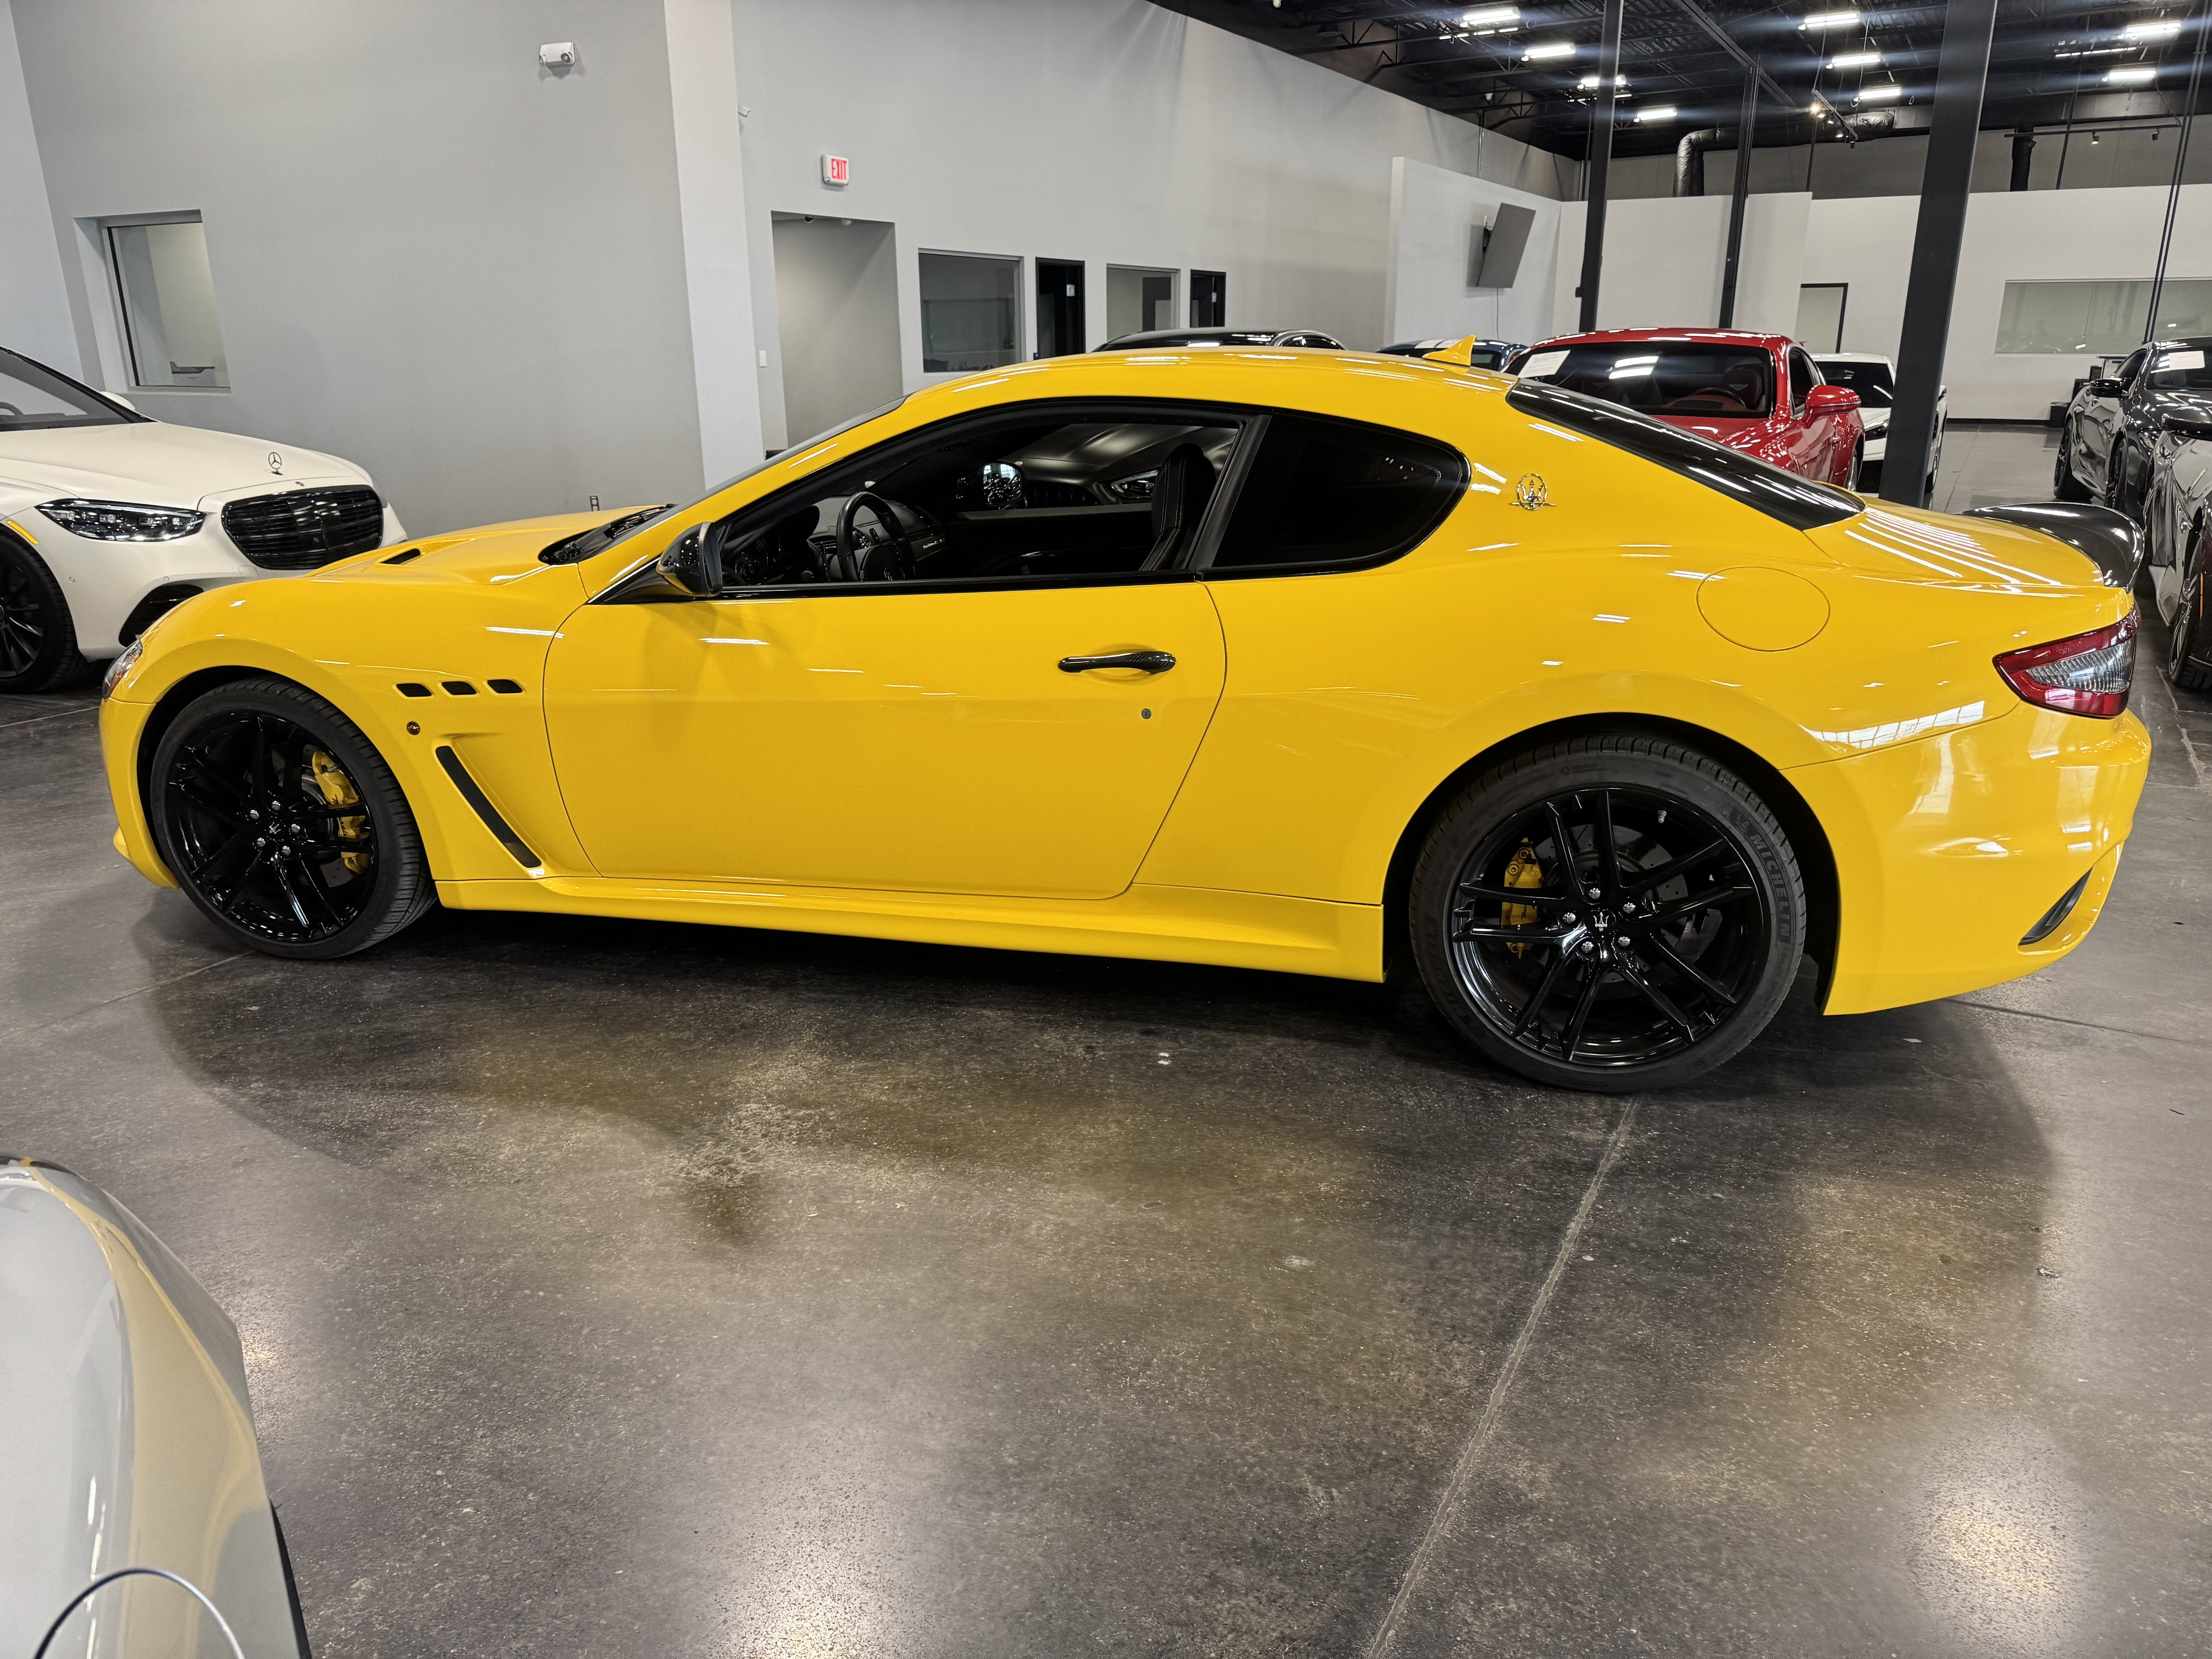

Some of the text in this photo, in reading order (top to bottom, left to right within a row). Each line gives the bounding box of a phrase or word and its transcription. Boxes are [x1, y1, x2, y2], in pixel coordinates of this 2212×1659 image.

[831, 158, 847, 180] EXIT
[1750, 834, 1790, 936] MICHELIN
[1776, 953, 1787, 977] PILOT
